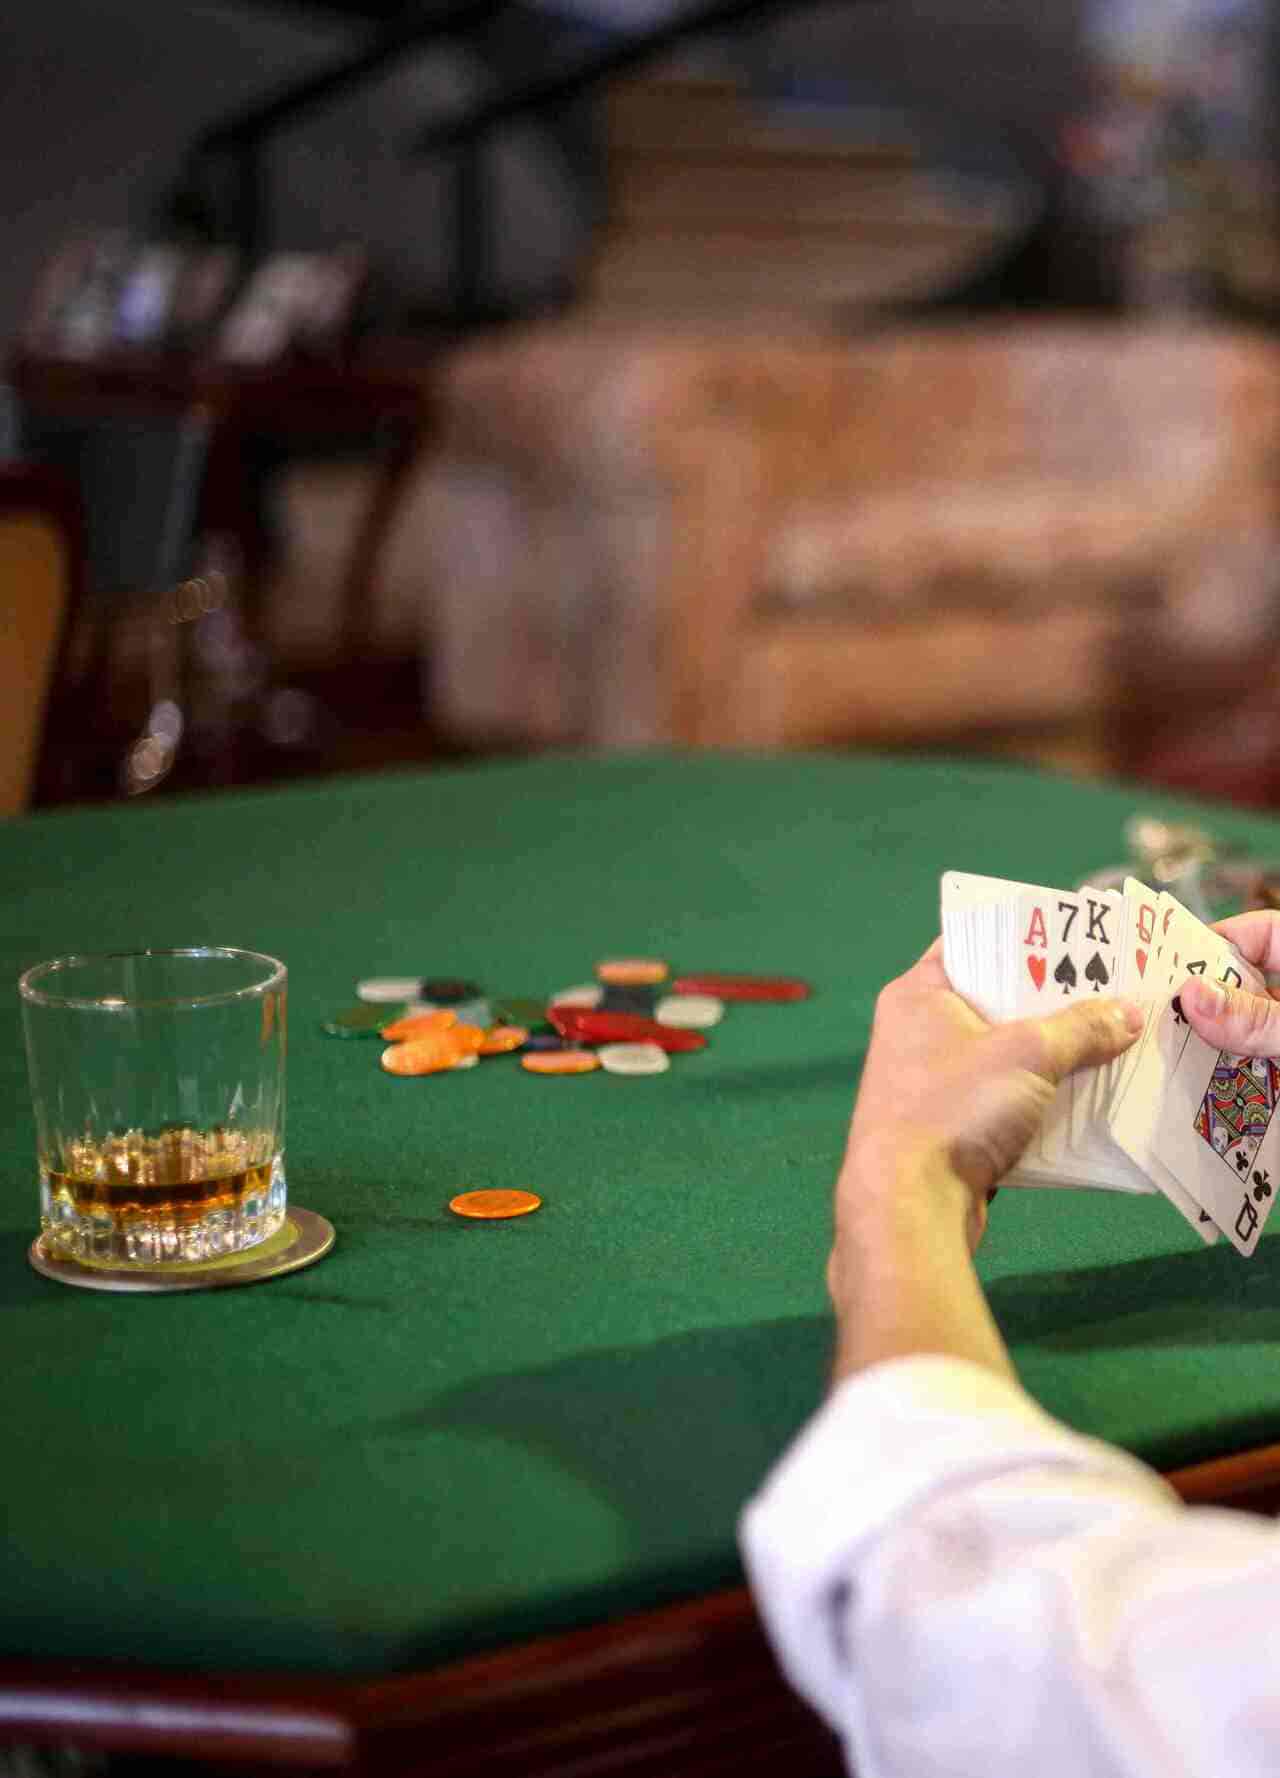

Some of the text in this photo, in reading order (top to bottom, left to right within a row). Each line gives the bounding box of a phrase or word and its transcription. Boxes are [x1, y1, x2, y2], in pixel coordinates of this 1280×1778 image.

[1023, 906, 1047, 948] A
[1057, 901, 1079, 943] 7
[1085, 898, 1111, 945] K
[1235, 1191, 1258, 1242] Q
